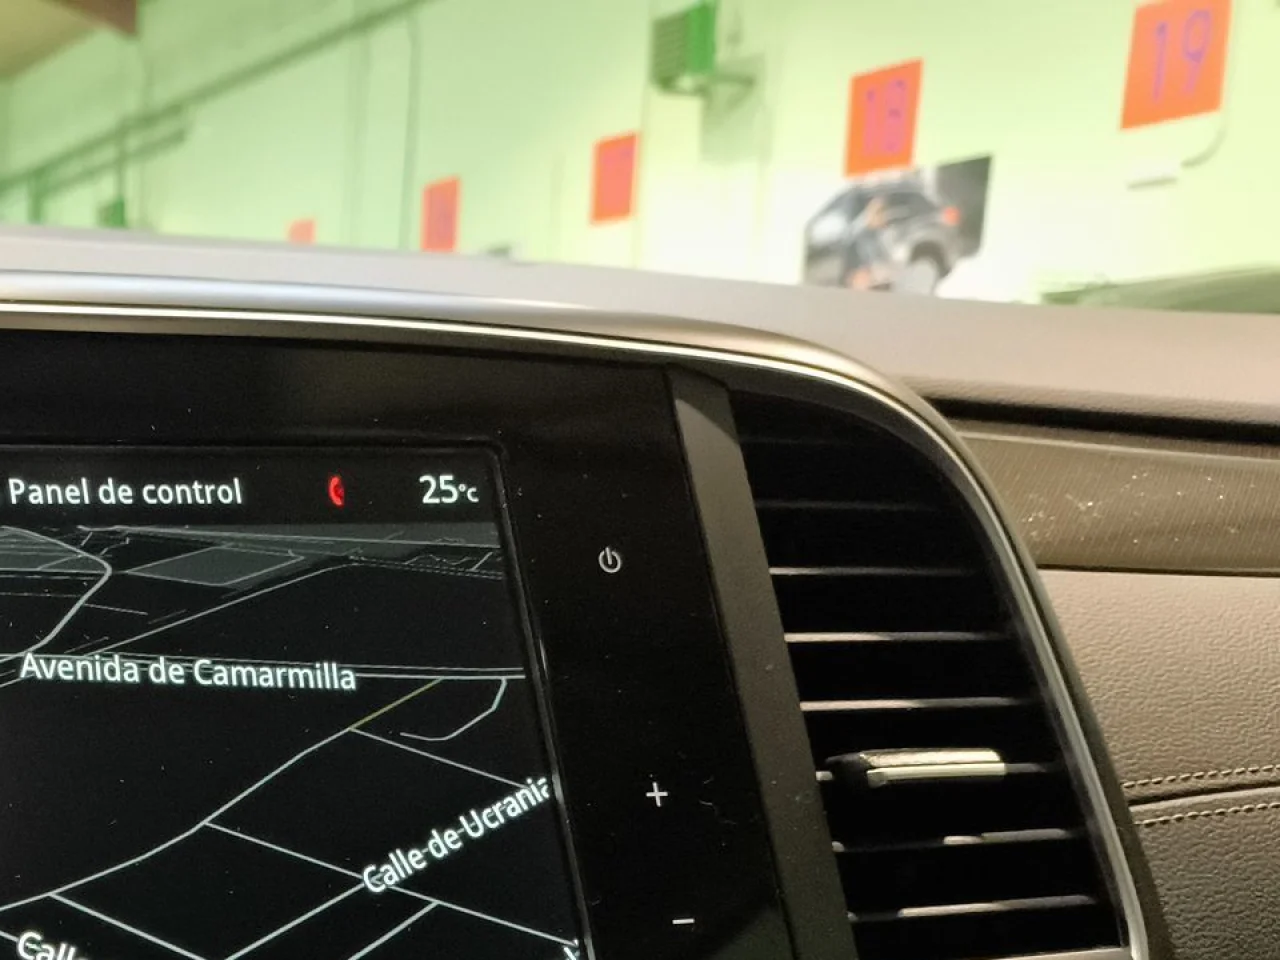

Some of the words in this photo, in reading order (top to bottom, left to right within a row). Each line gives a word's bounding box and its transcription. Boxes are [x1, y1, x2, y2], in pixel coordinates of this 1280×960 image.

[1152, 8, 1213, 104] 19
[8, 477, 90, 505] Panel
[98, 477, 133, 505] de
[142, 477, 242, 505] control
[20, 653, 140, 684] Avenida
[148, 656, 185, 685] de
[193, 658, 357, 691] Camarmilla
[363, 848, 428, 893] Calle
[428, 828, 463, 858] de
